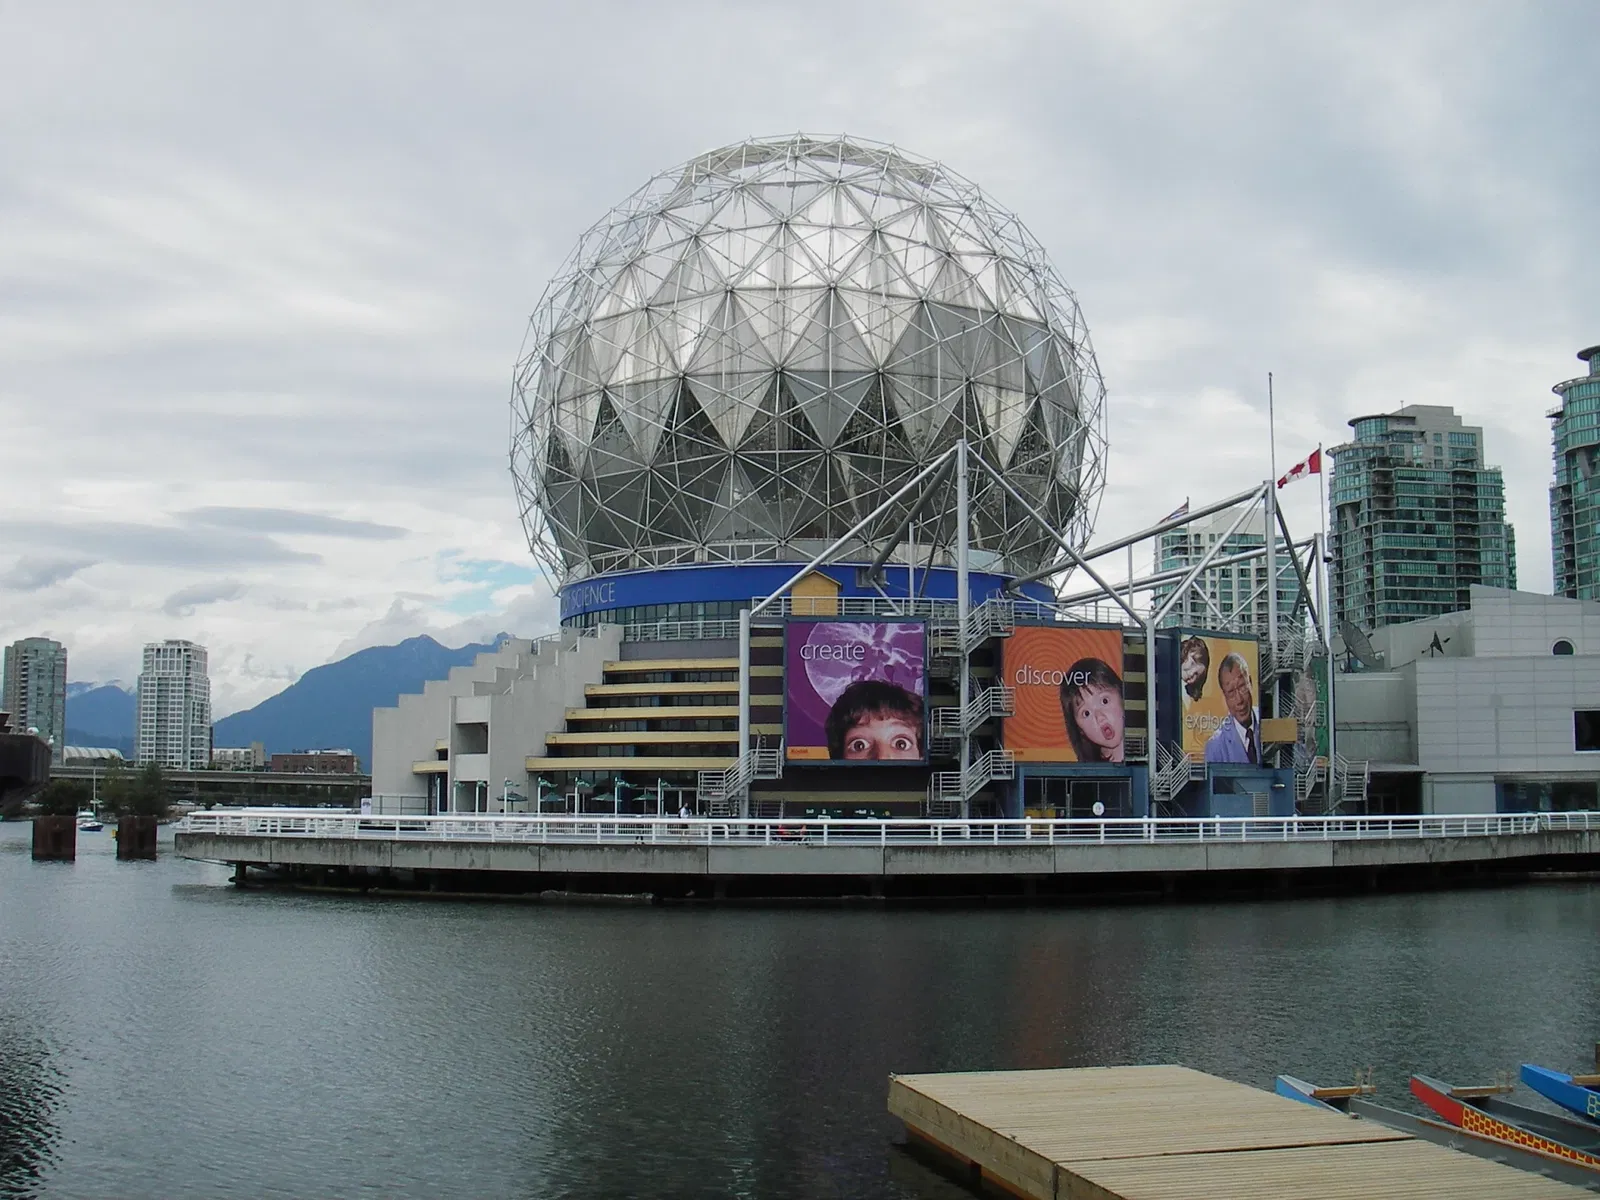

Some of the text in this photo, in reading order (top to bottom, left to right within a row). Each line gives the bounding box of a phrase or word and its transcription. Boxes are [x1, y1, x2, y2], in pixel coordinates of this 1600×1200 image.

[571, 581, 616, 610] SCIENCE
[800, 642, 865, 660] create
[1015, 664, 1091, 686] discover
[1185, 710, 1232, 734] explore
